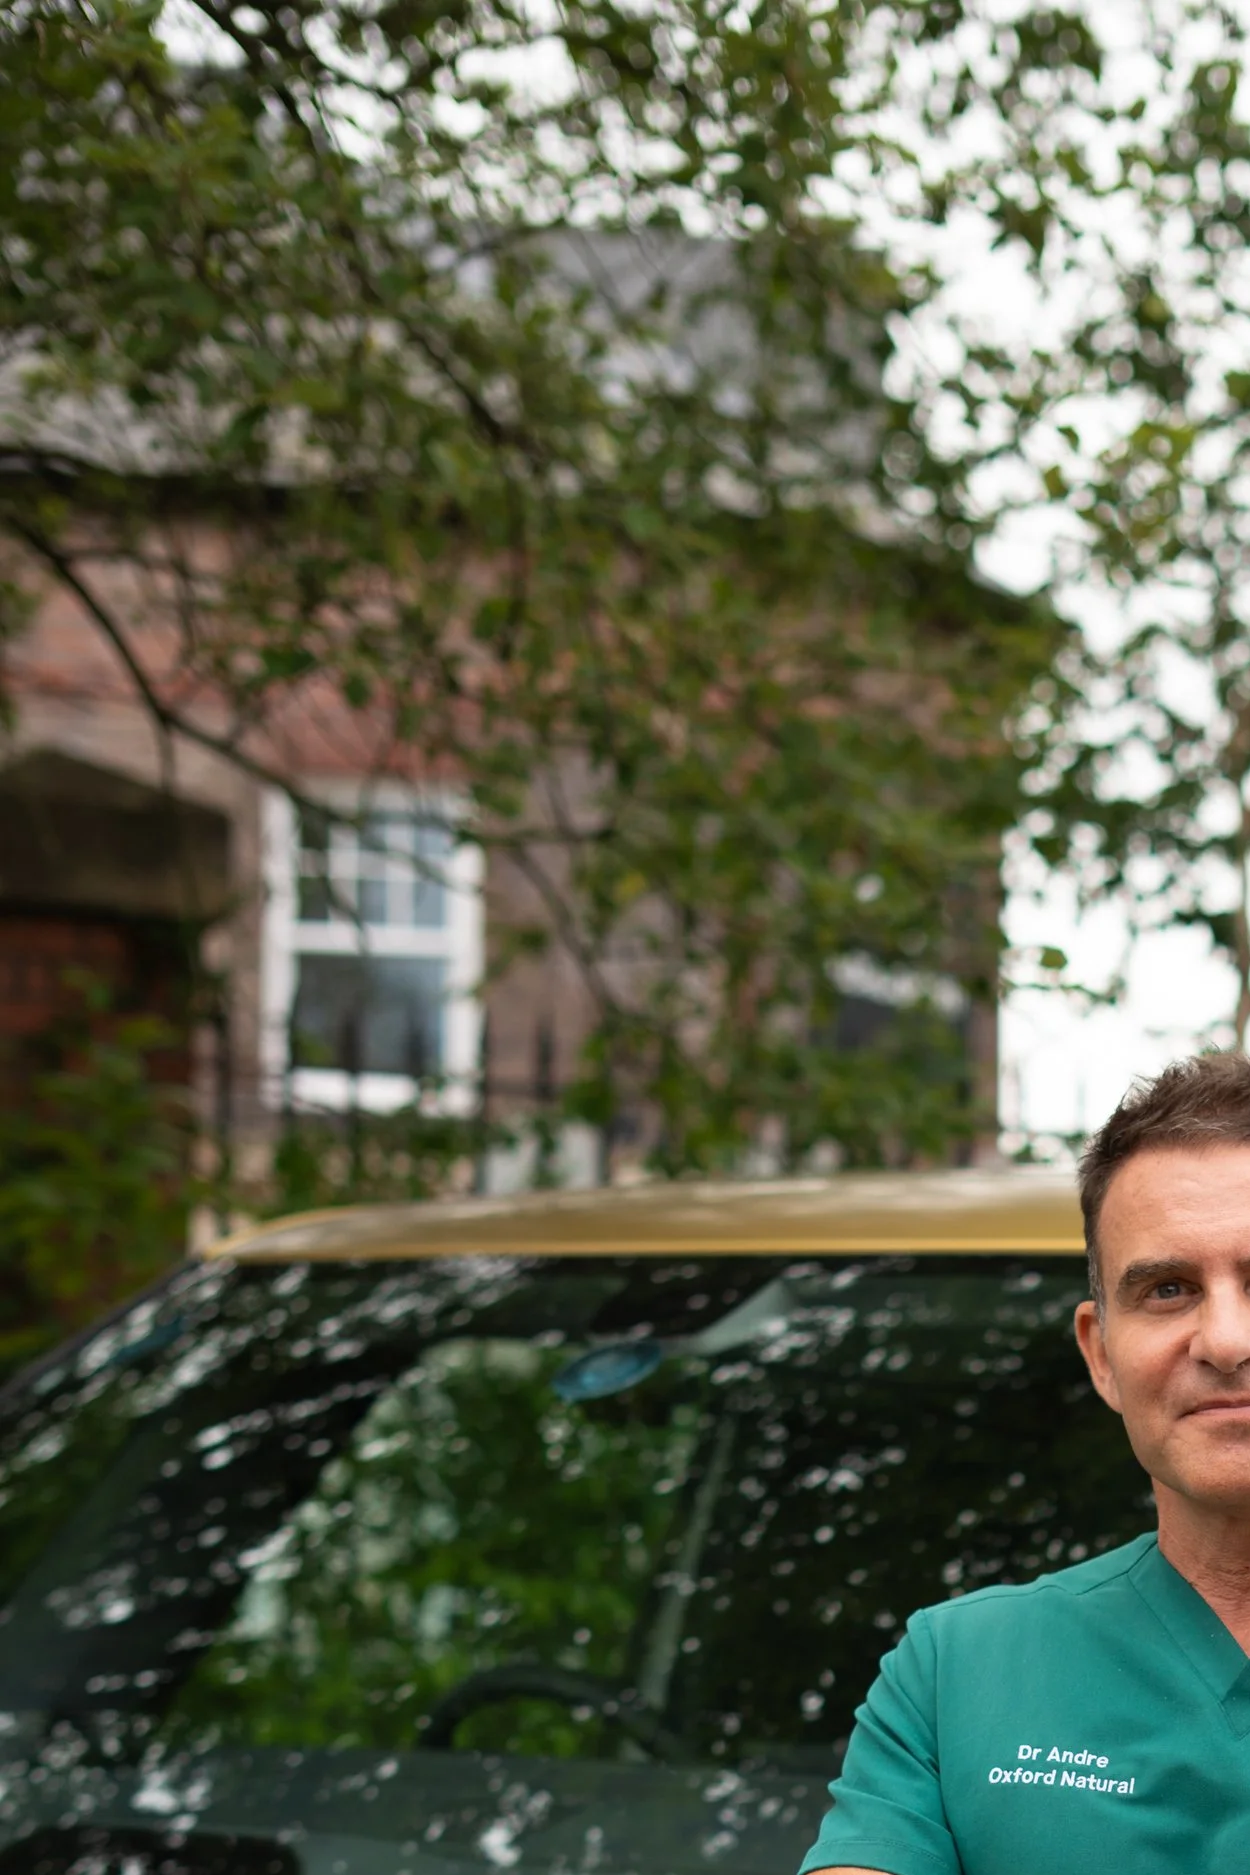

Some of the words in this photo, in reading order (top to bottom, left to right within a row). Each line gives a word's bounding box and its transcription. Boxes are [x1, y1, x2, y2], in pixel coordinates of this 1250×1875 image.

[1017, 1744, 1042, 1761] Dr
[1046, 1746, 1109, 1768] Andre
[988, 1767, 1057, 1785] Oxford
[1060, 1771, 1135, 1794] Natural
